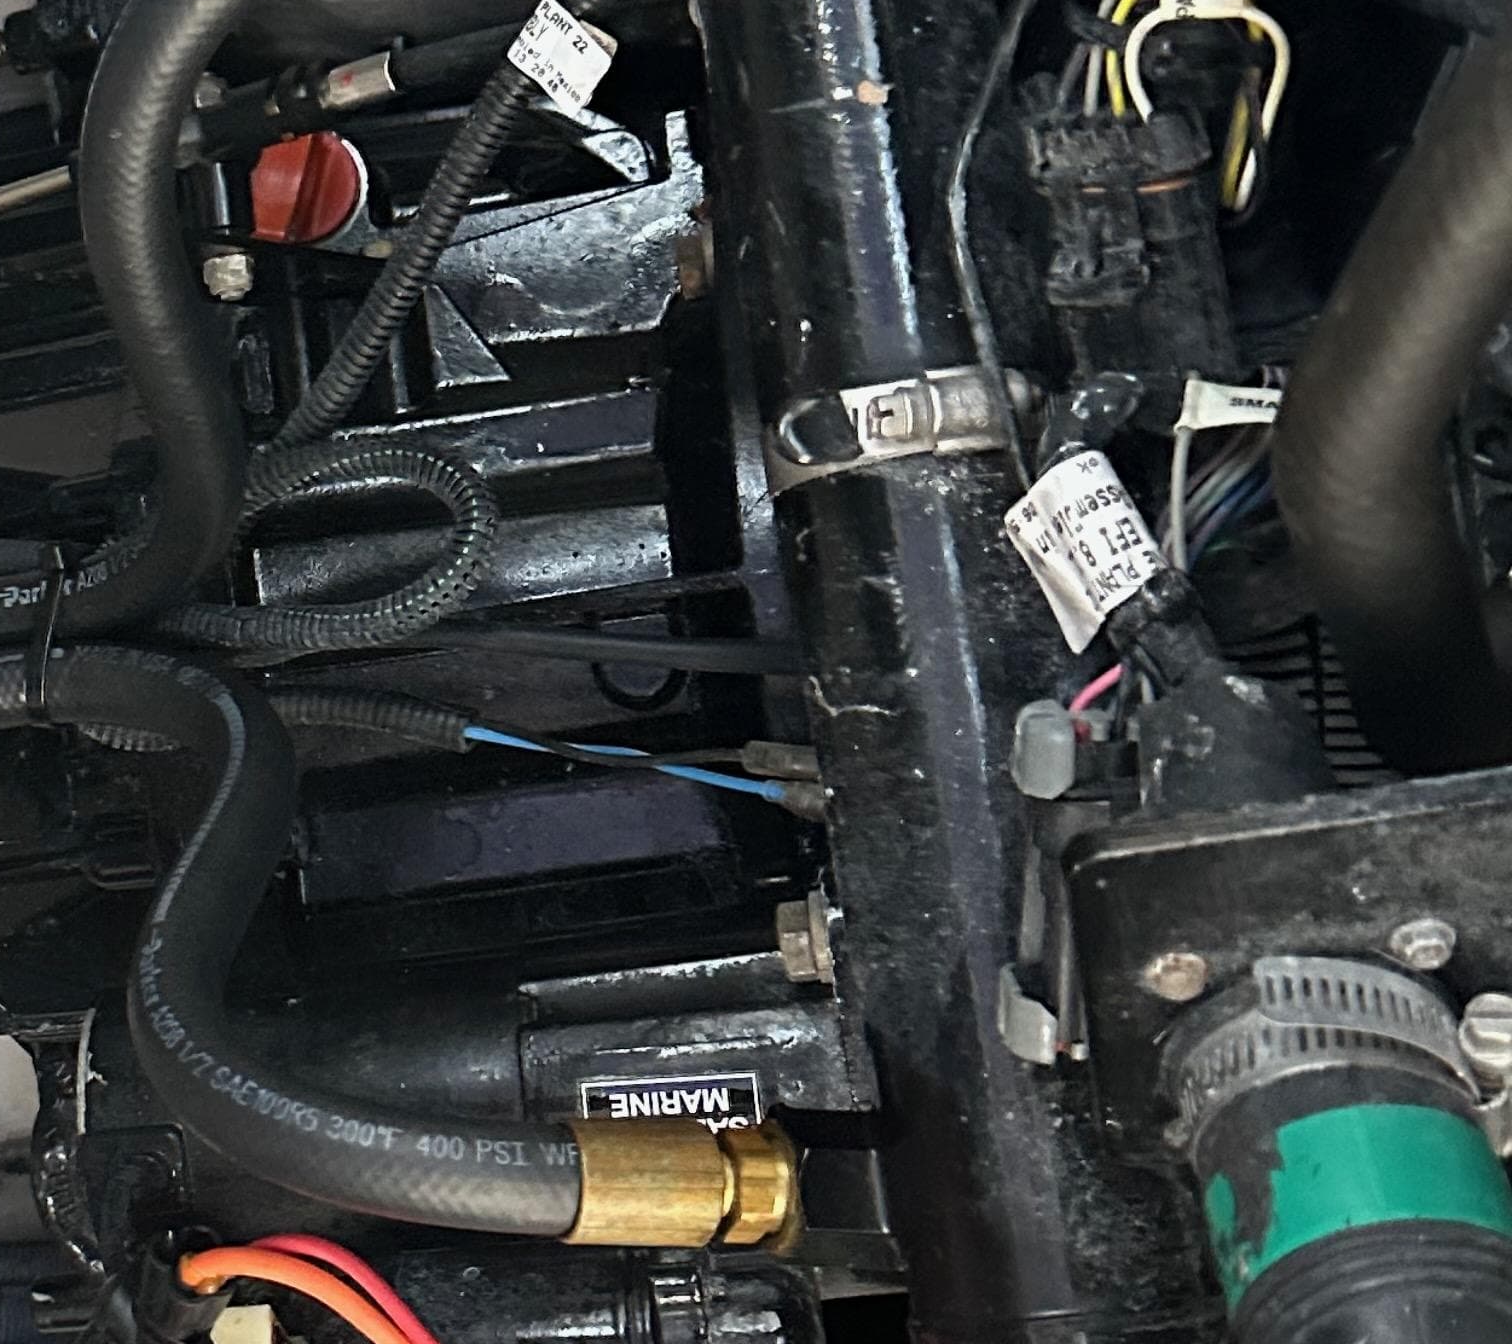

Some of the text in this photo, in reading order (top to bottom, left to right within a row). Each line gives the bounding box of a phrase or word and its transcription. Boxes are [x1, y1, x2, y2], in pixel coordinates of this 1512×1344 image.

[539, 1, 588, 54] PLANT 22
[1098, 516, 1143, 556] EFI
[1092, 560, 1141, 602] PLANT
[607, 1086, 730, 1118] MARINE
[416, 1132, 465, 1161] 400
[474, 1139, 530, 1168] PSI
